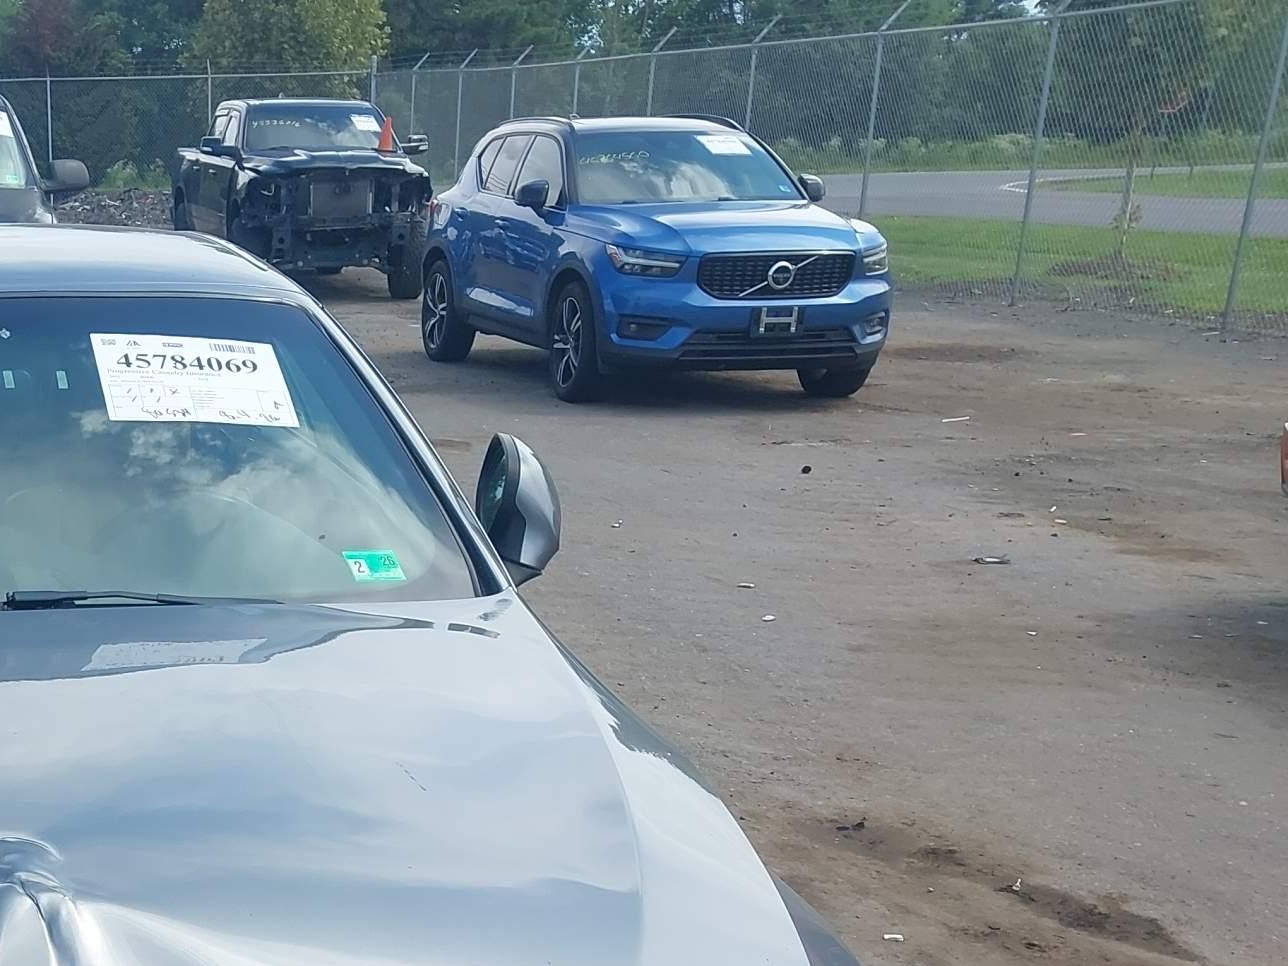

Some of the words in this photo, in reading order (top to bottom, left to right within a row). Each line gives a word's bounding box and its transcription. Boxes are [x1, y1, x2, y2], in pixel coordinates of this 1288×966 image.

[116, 353, 258, 374] 45784069
[354, 561, 366, 573] 2
[380, 555, 396, 567] 26
